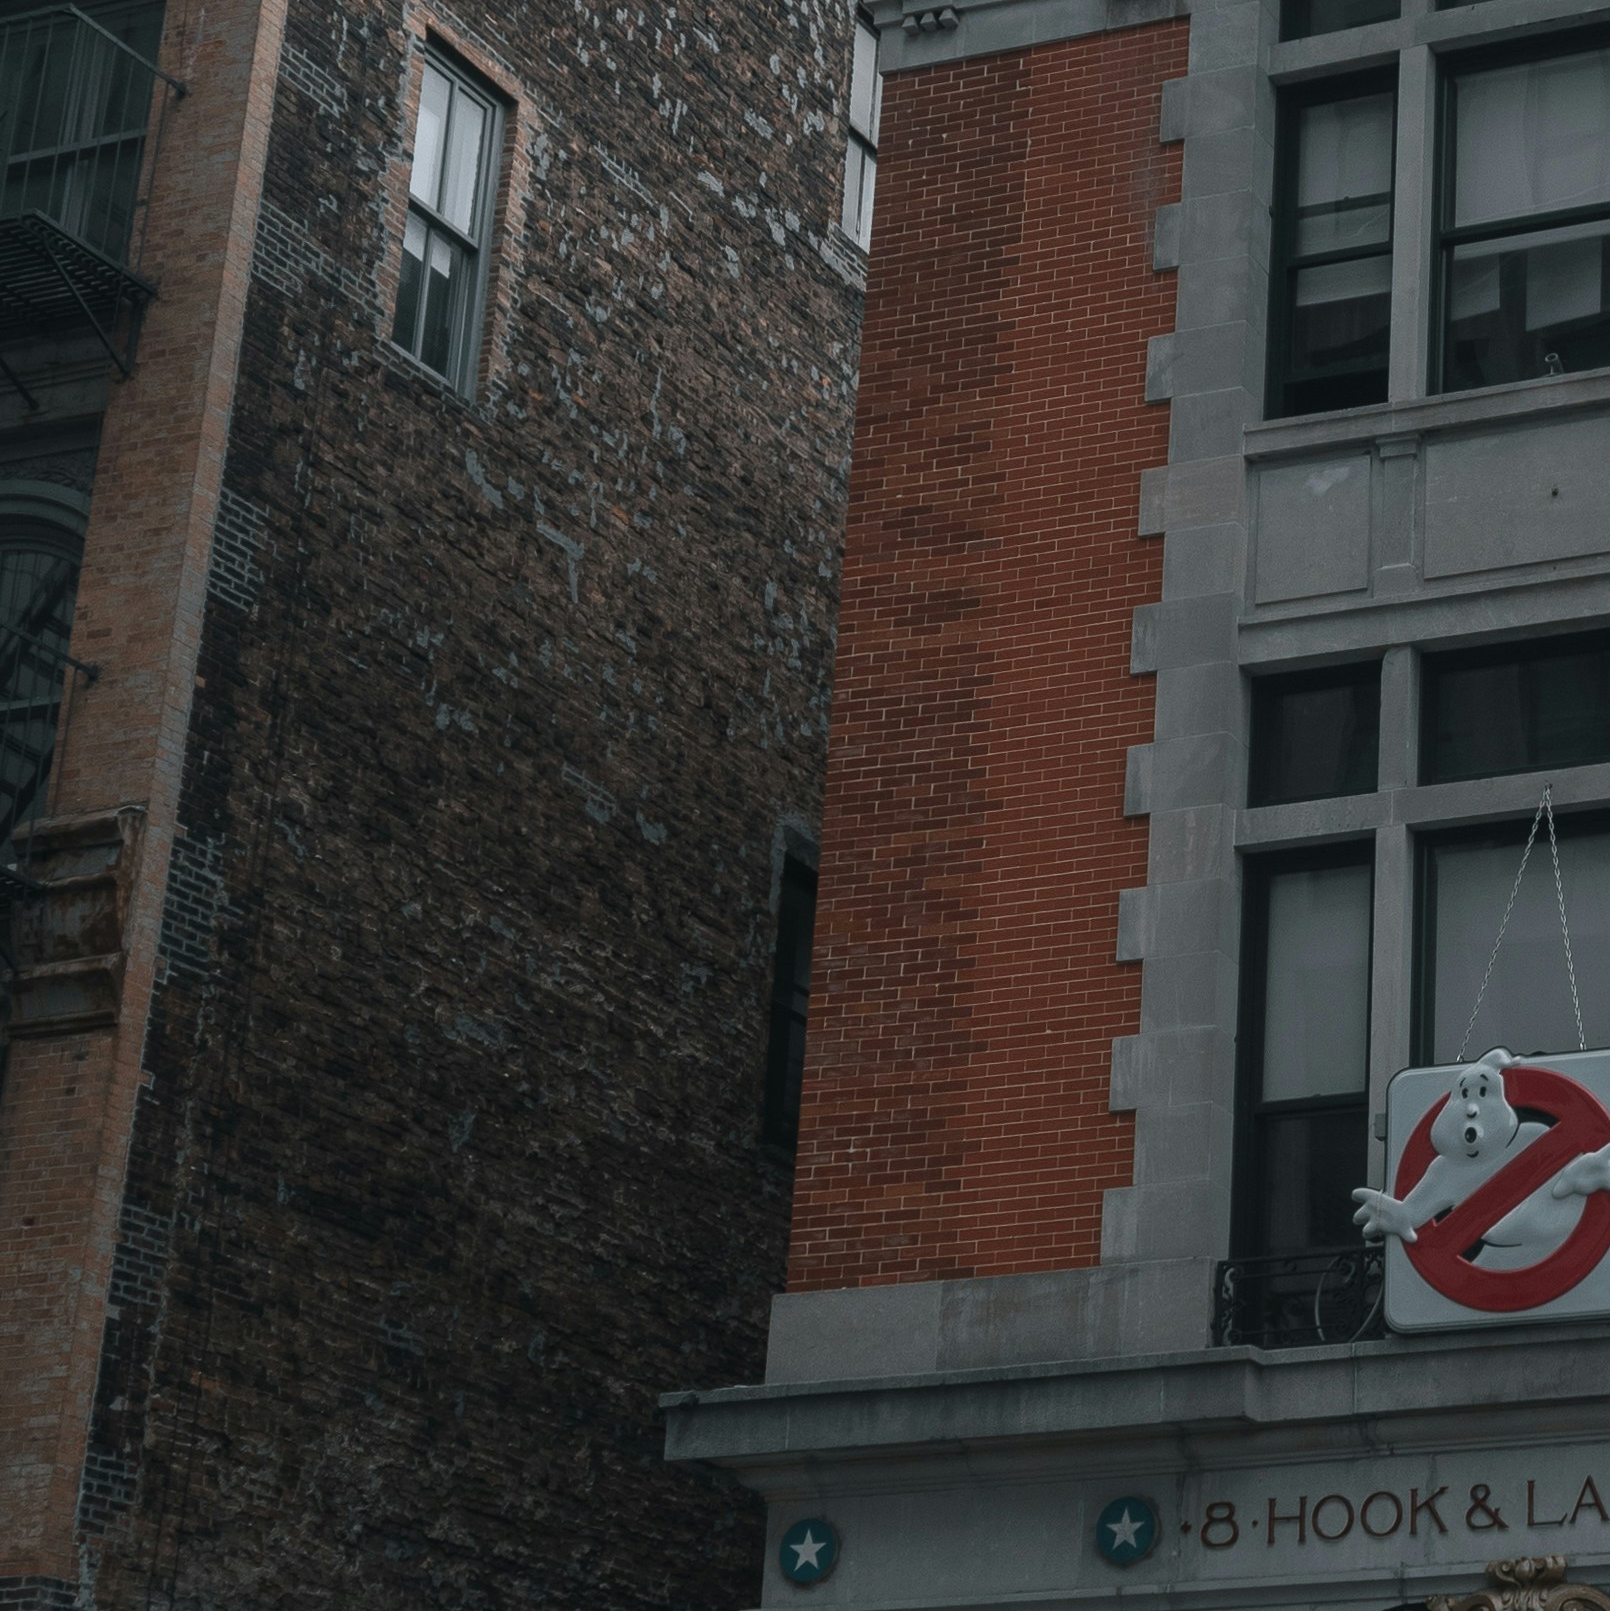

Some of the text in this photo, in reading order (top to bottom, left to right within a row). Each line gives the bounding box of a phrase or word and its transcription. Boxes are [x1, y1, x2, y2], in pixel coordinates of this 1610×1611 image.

[1200, 1501, 1239, 1548] 8
[1266, 1486, 1449, 1546] HOOK
[1465, 1483, 1509, 1530] &
